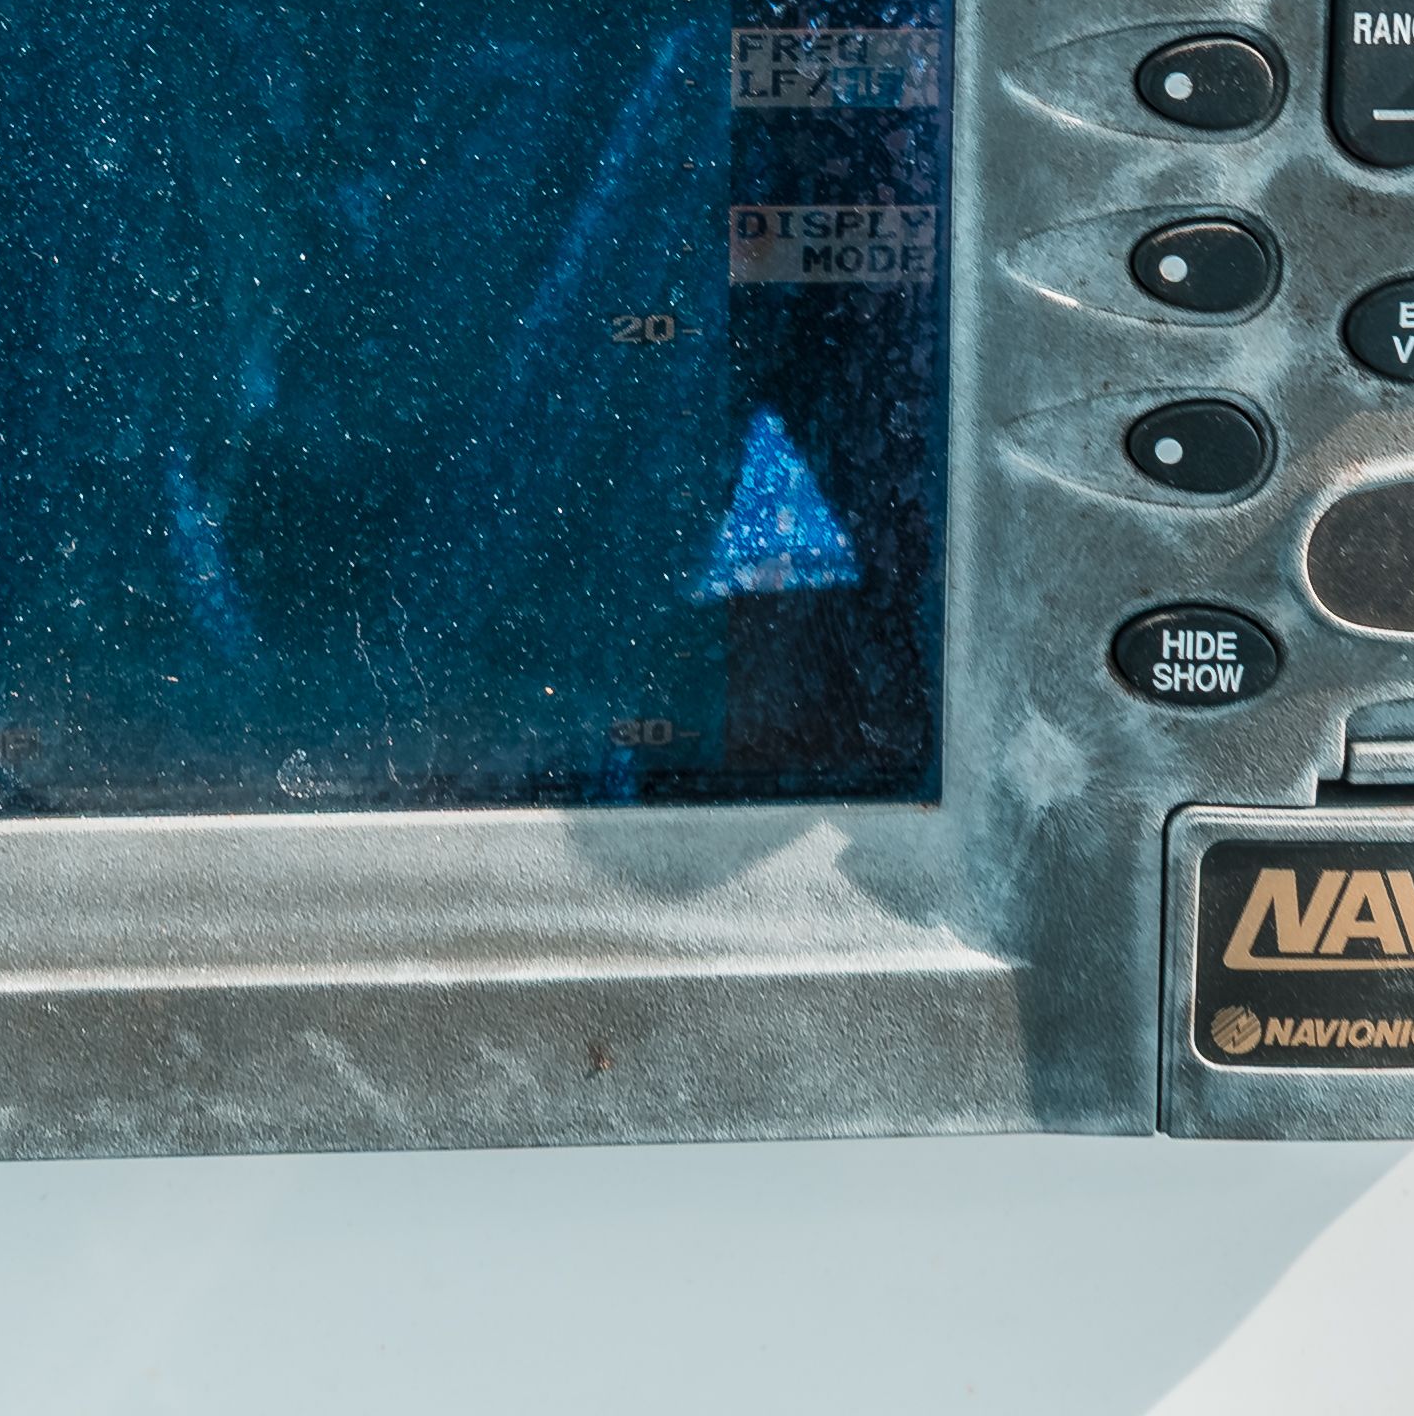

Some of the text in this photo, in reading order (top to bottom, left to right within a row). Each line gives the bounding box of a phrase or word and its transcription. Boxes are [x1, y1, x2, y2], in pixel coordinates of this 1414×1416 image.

[737, 210, 932, 240] DISPLY
[801, 244, 933, 274] MODE
[612, 314, 676, 343] 20
[1162, 629, 1238, 661] HIDE
[1152, 662, 1245, 693] SHOW
